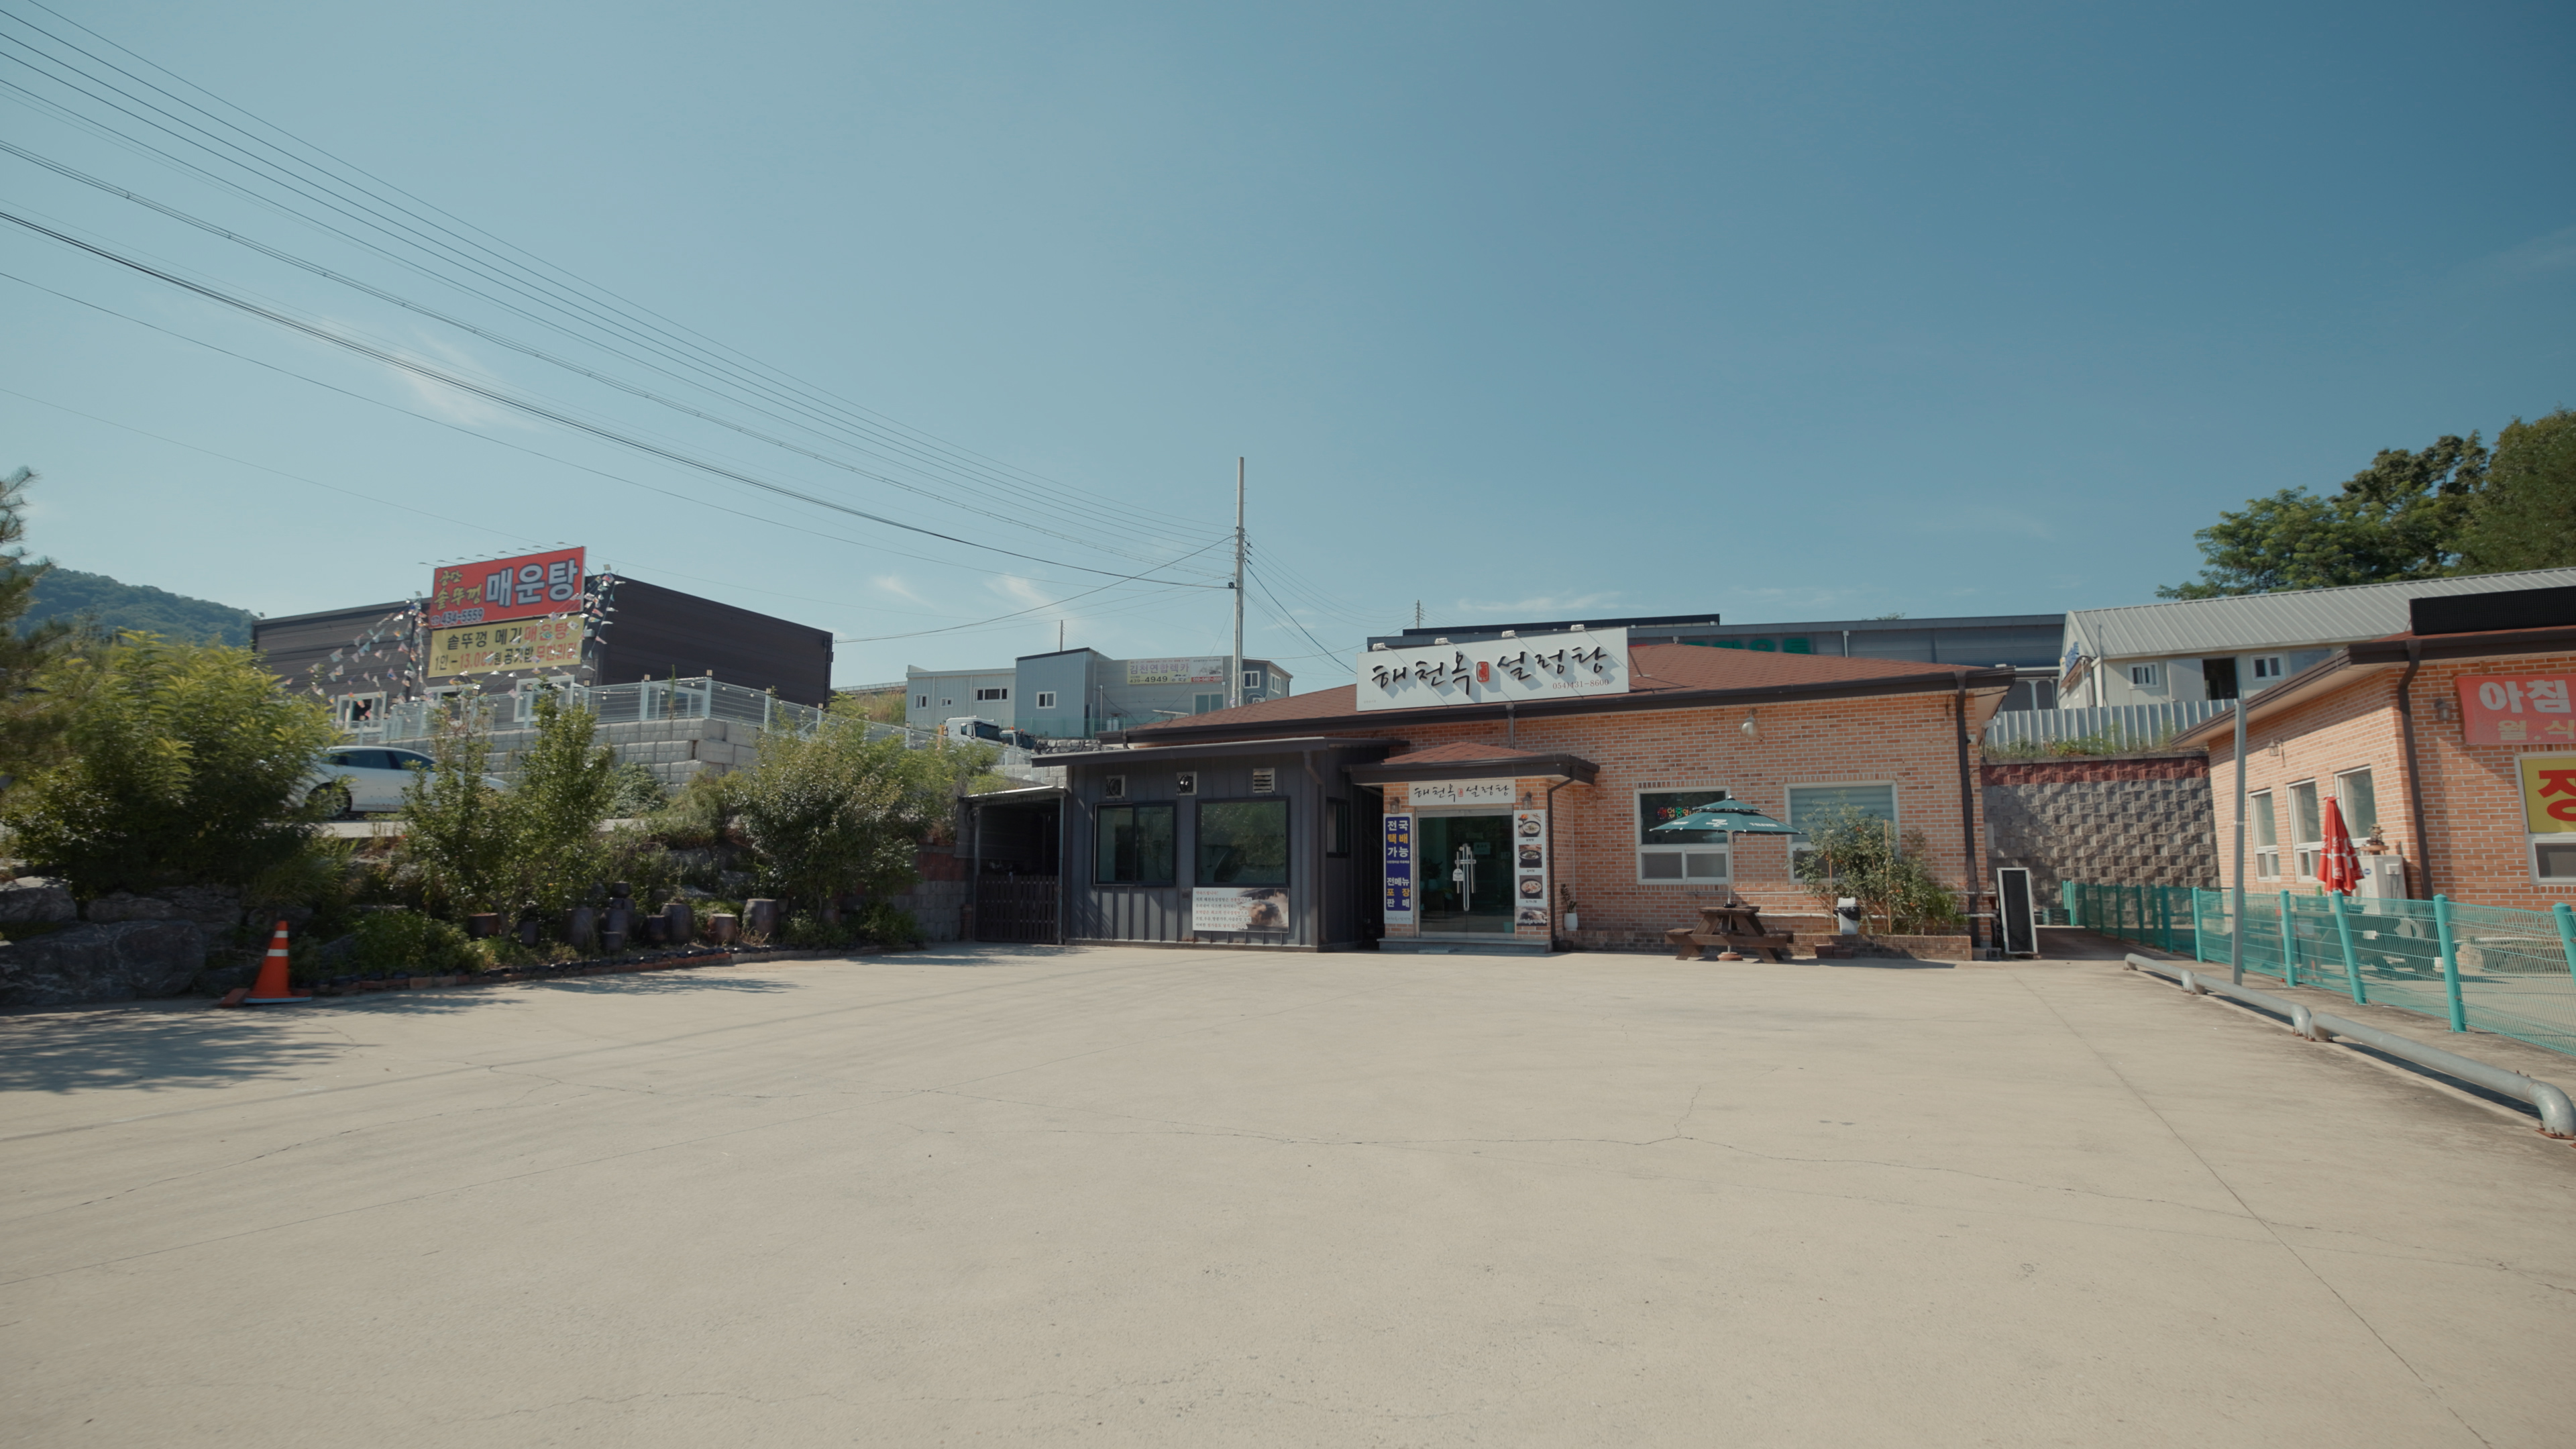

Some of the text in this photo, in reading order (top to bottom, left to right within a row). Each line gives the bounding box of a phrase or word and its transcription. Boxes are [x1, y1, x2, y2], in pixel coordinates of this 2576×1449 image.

[438, 570, 464, 587] 공단
[485, 558, 580, 607] 매운탕
[433, 583, 482, 610] 솥뚜껑
[447, 622, 569, 650] 솥뚜껑 메기 매운탕
[435, 655, 448, 670] 1인
[1130, 662, 1189, 675] 김천연합렉카
[1372, 646, 1607, 695] 해천옥 설렁탕
[1552, 679, 1609, 690] 054)431-8600
[2479, 680, 2571, 713] 아침
[1414, 784, 1510, 803] 해천옥 설렁탕
[1387, 820, 1409, 831] 전국
[1387, 833, 1408, 844] 택배
[1387, 847, 1409, 857] 가능
[1387, 877, 1410, 886] 전메뉴
